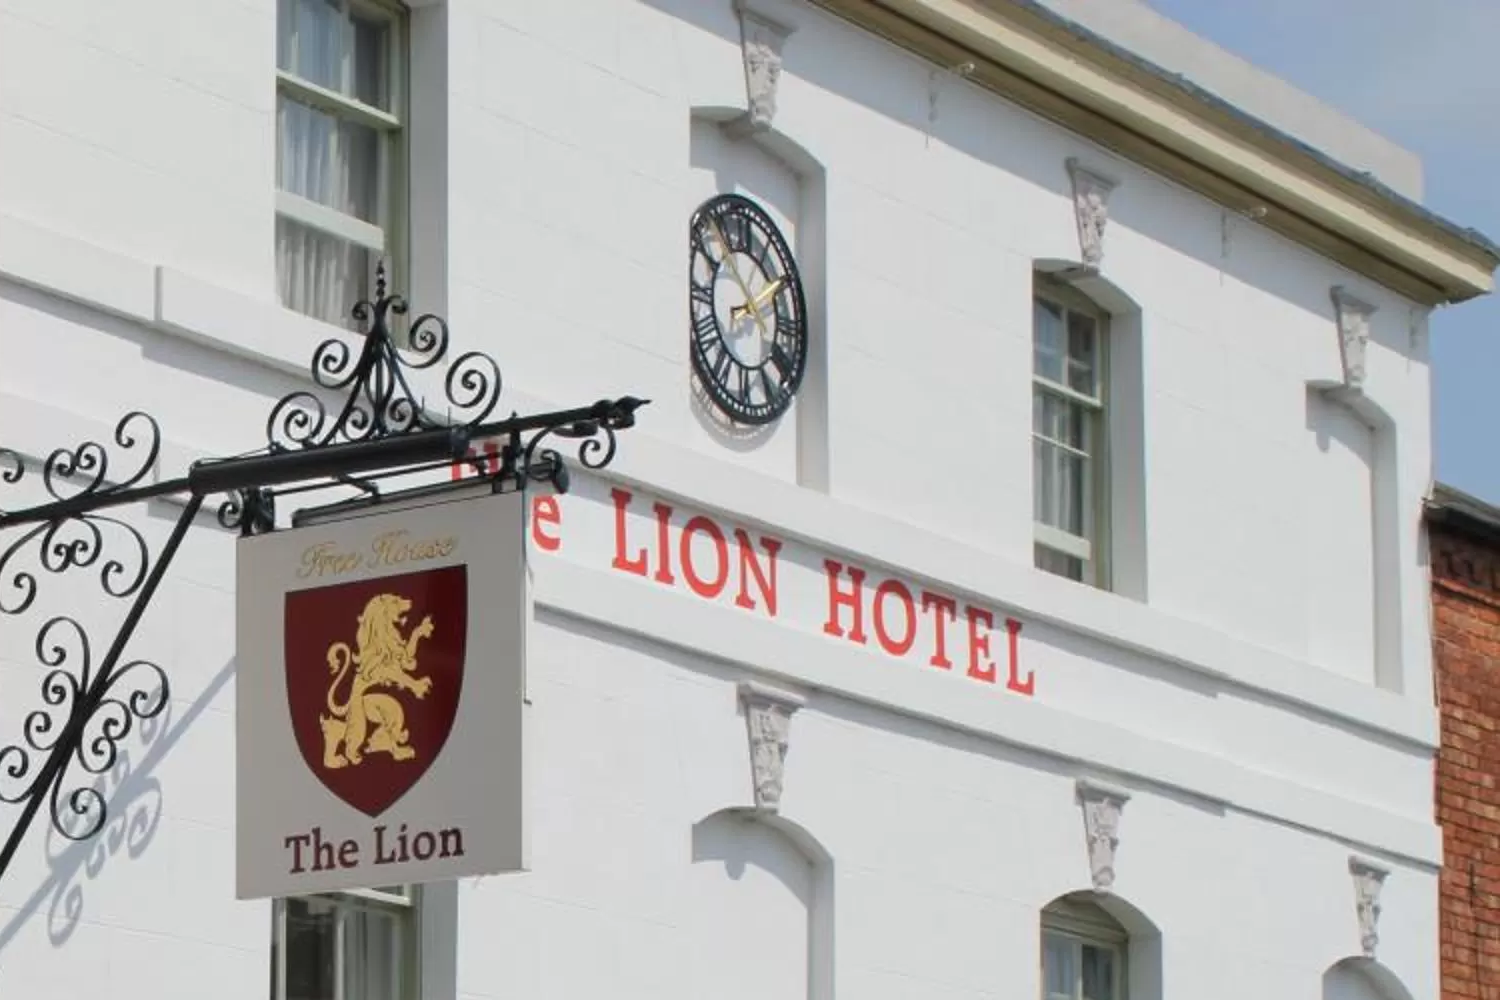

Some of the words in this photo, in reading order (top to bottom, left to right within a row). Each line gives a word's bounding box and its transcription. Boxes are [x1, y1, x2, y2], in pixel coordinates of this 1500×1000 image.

[611, 488, 781, 617] LION
[824, 560, 1035, 697] HOTEL
[284, 826, 360, 875] The
[372, 819, 465, 867] Lion
